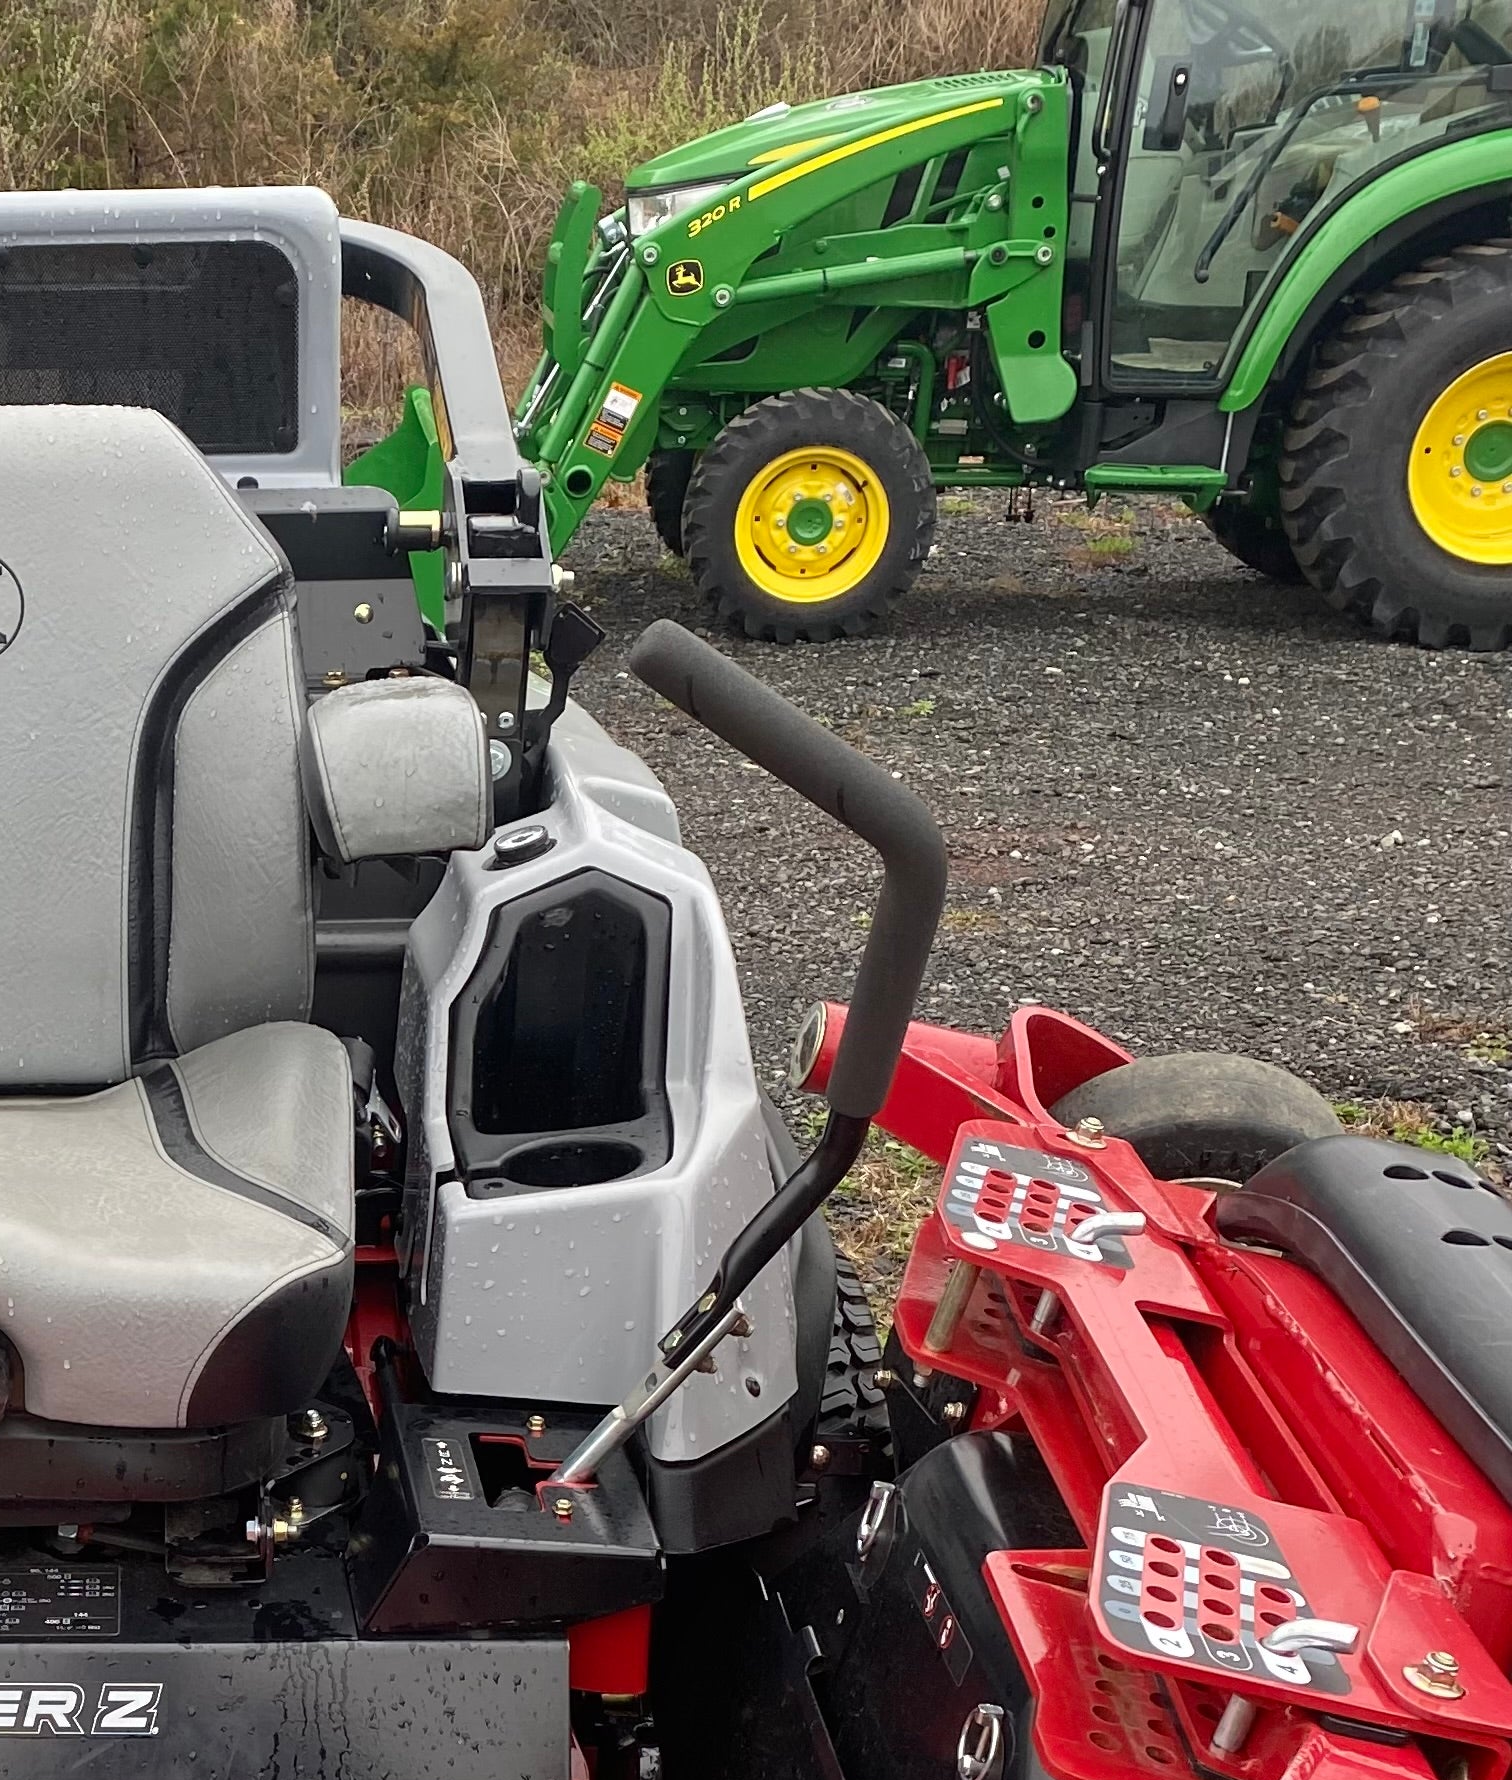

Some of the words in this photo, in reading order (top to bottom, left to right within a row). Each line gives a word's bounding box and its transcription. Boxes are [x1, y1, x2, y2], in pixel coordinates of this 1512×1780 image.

[687, 205, 726, 238] 320
[728, 195, 741, 213] R
[1159, 1636, 1183, 1649] 2
[1216, 1650, 1241, 1662] 3
[1275, 1663, 1299, 1675] 4
[91, 1682, 164, 1735] Z
